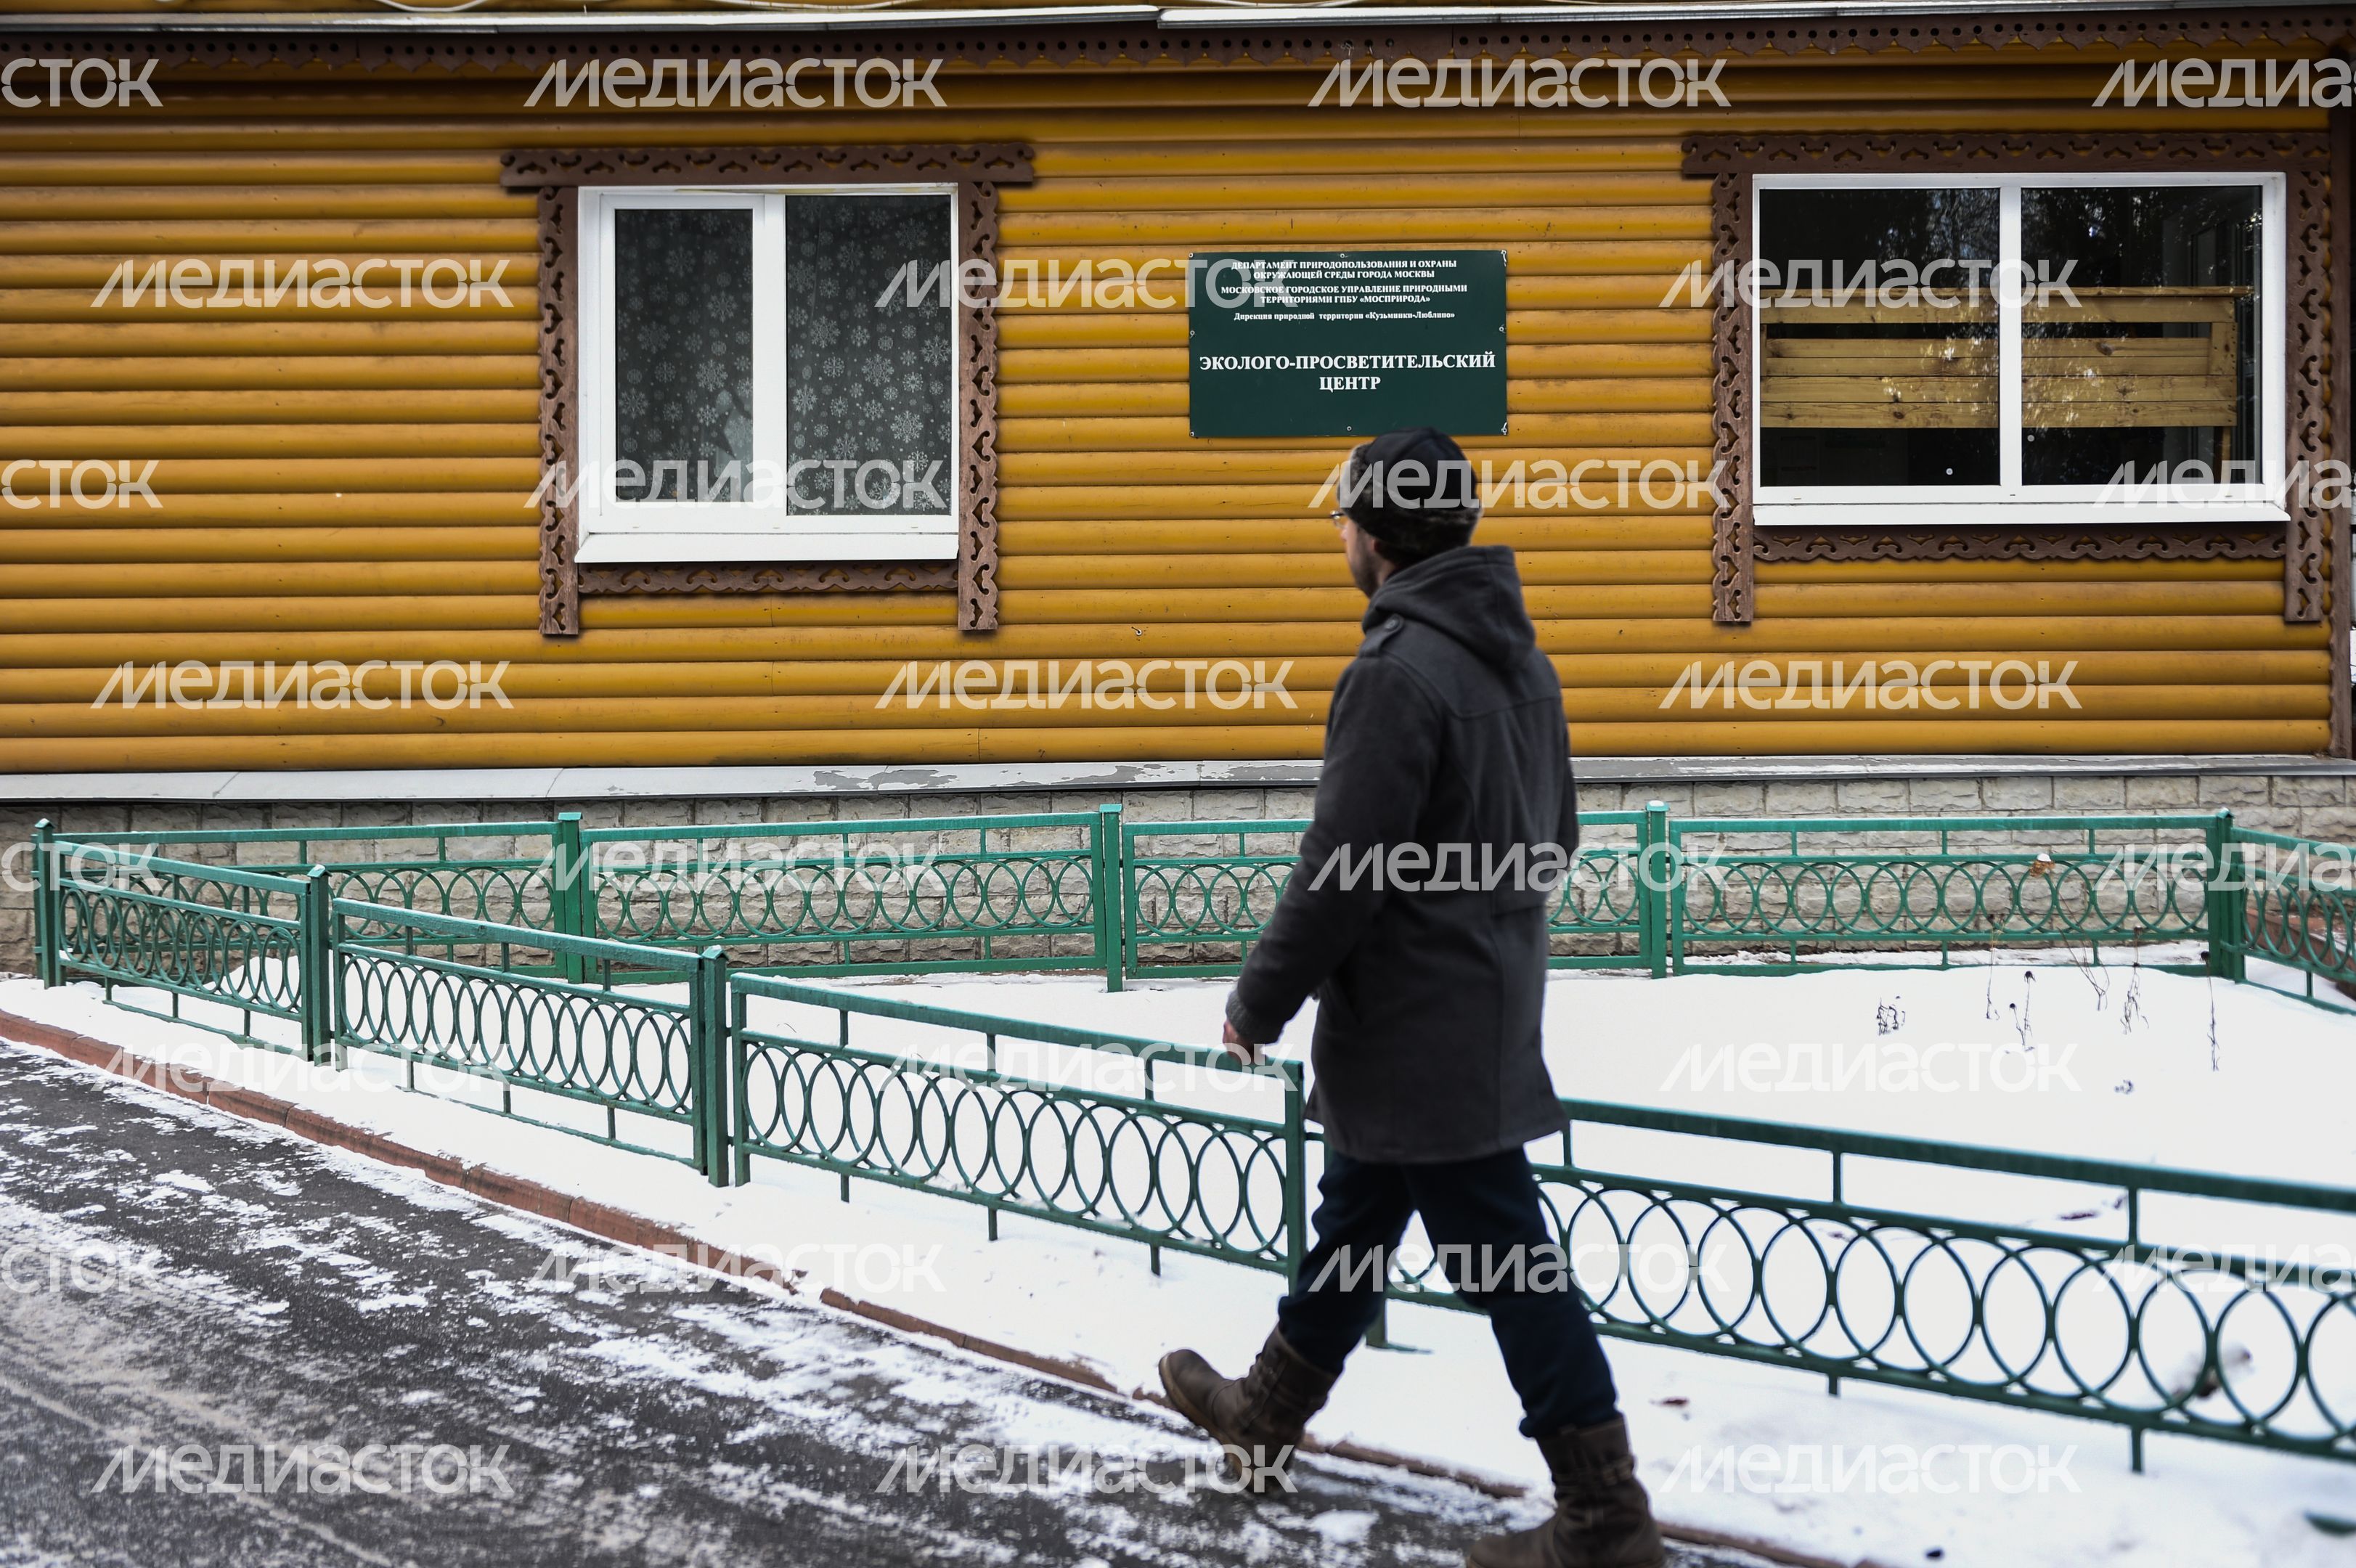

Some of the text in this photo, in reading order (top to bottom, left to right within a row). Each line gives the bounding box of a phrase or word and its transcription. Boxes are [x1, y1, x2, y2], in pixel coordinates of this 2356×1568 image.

[1231, 261, 1297, 270] ДЕПАРТАМЕНТ
[1300, 261, 1408, 270] ПРИРОДОПОЛЬЗОВАНИЯ
[1418, 259, 1456, 268] ОХРАНЫ
[1253, 269, 1435, 279] ОКРУЖАЮЩЕЙ СРЕДЫ ГОРОДА МОСКВЫ
[1286, 285, 1339, 294] ГОРОДСКОЕ
[1341, 285, 1401, 293] УПРАВЛЕНИЕ
[1403, 284, 1468, 293] ПРИРОДНЫМИ
[1260, 295, 1430, 304] ТЕРРИТОРИЯМИ ГПБУ «МОСПРИРОДА»
[1274, 312, 1315, 322] природной
[1318, 312, 1364, 322] территории
[1199, 351, 1496, 370] ЭКОЛОГО-ПРОСВЕТИТЕЛЬСКИЙ
[1319, 376, 1381, 393] ЦЕНТР
